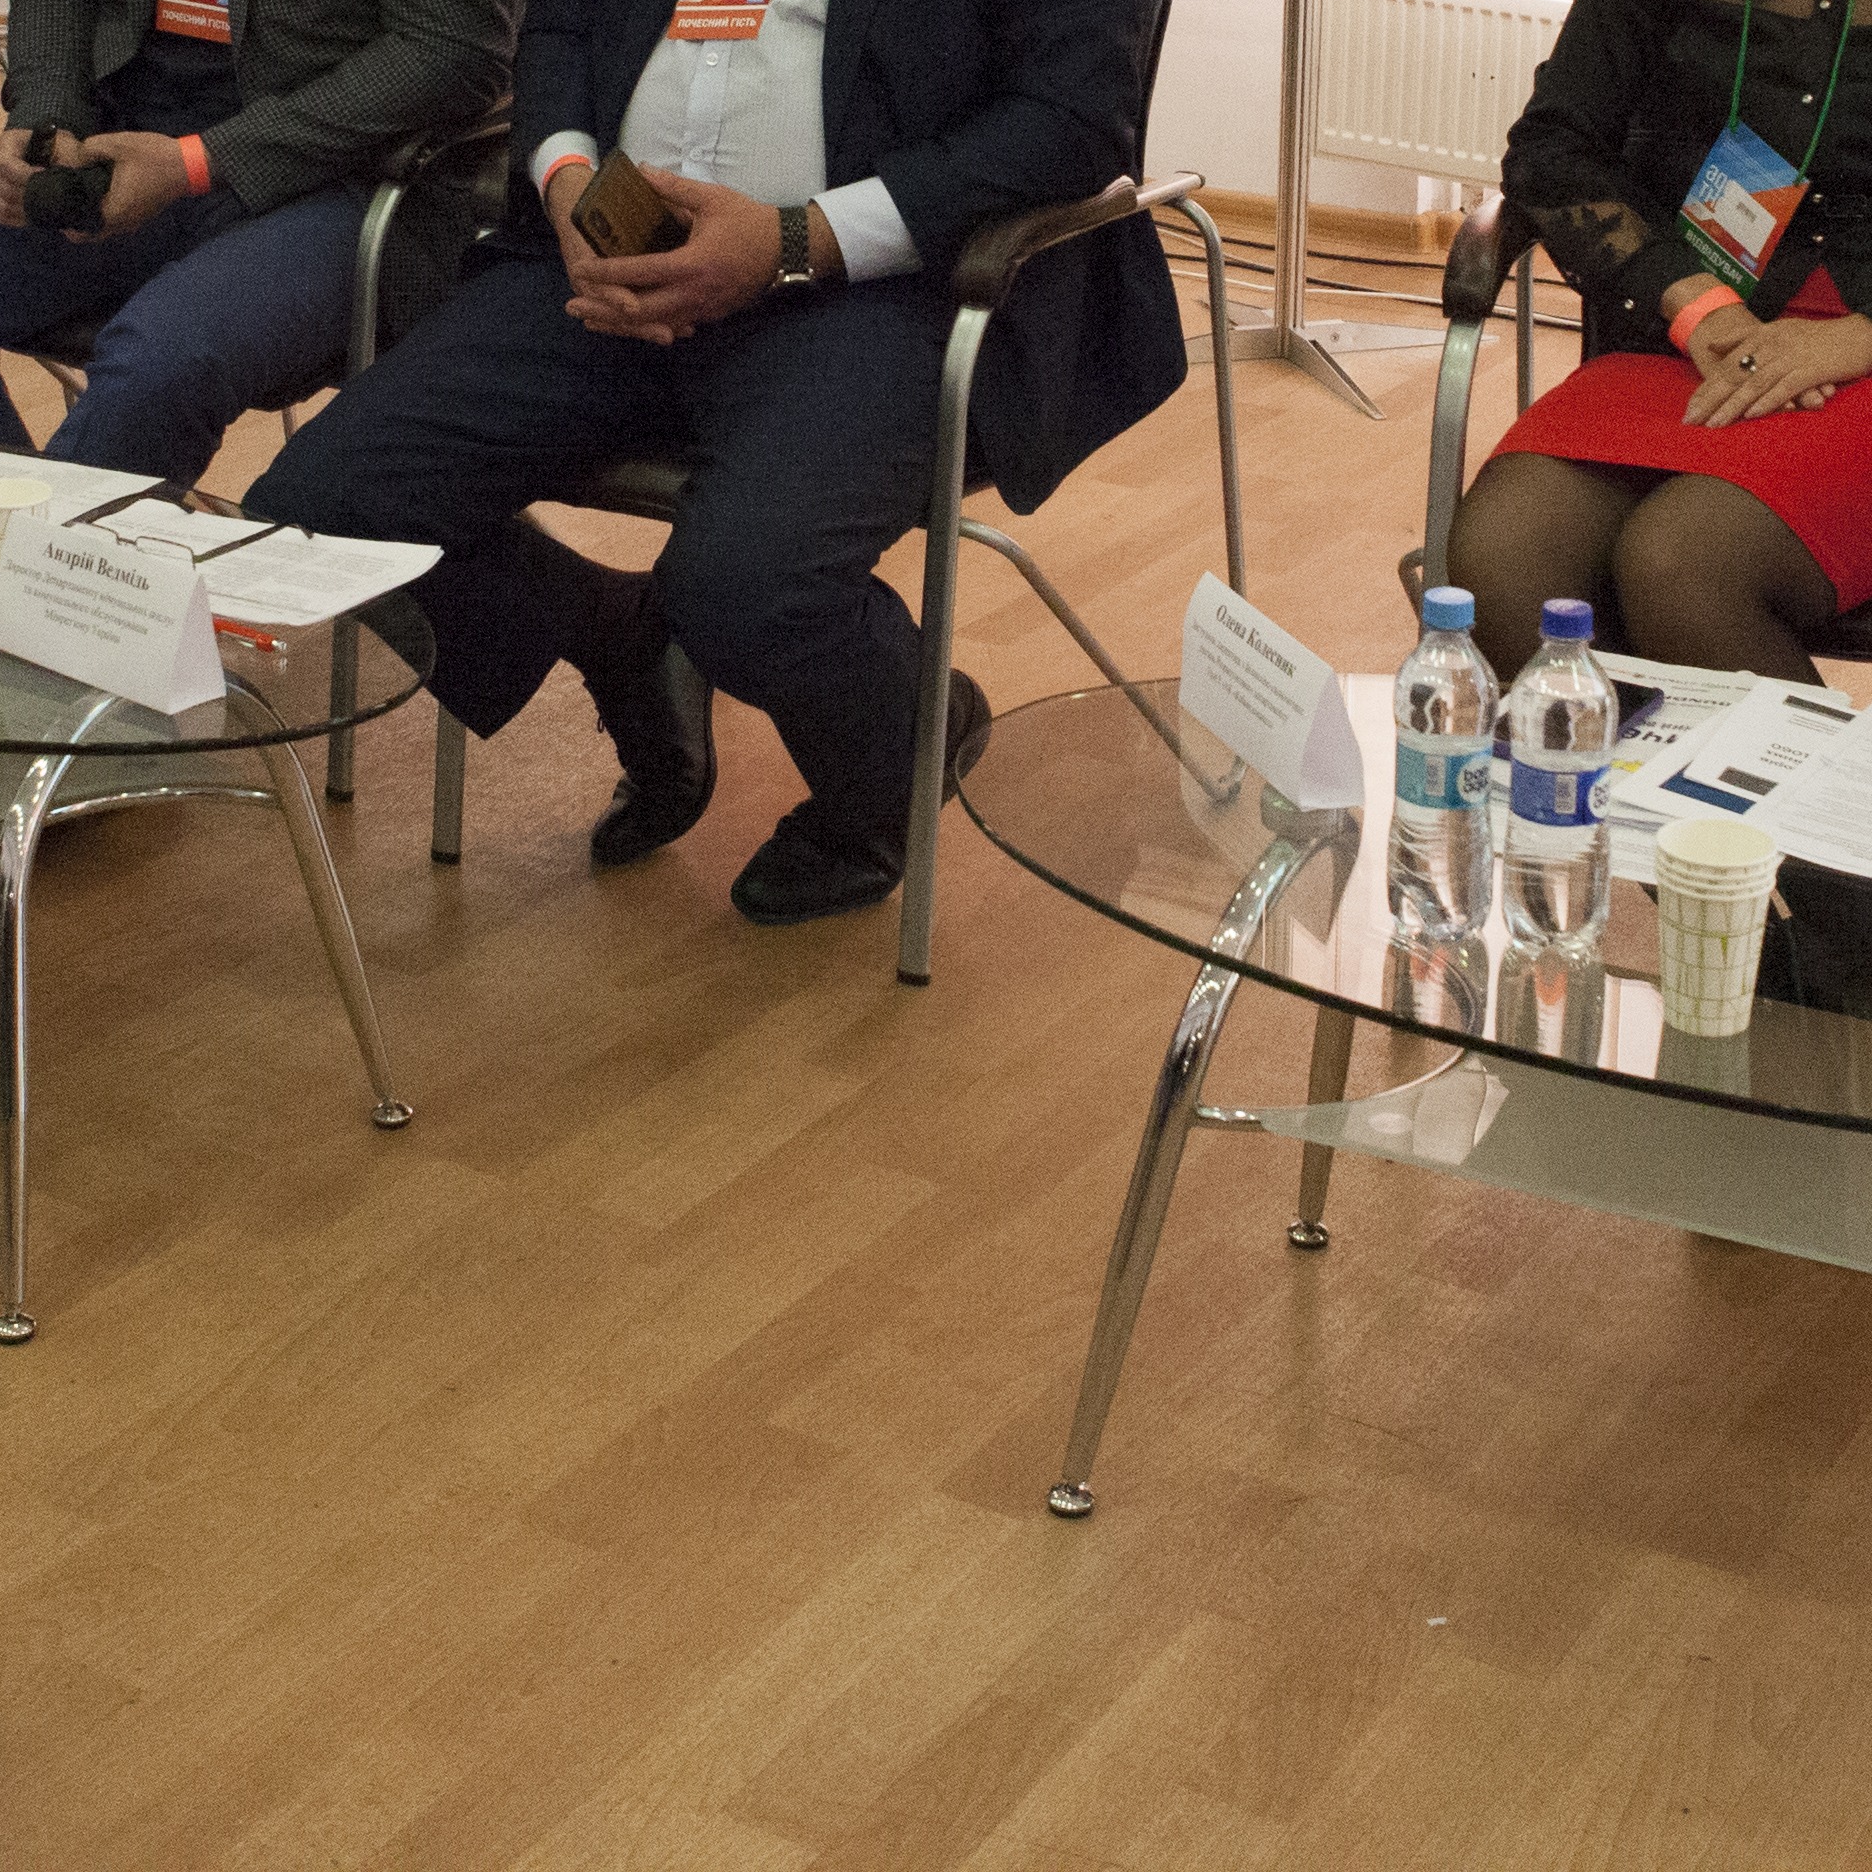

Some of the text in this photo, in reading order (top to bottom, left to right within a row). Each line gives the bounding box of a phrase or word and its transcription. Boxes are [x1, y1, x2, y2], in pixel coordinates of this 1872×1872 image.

[676, 15, 757, 29] ПОЧЕСНИЙ ГІСТЬ
[42, 541, 94, 572] Андрій
[1215, 604, 1247, 640] Олена
[1246, 627, 1297, 679] Колесник
